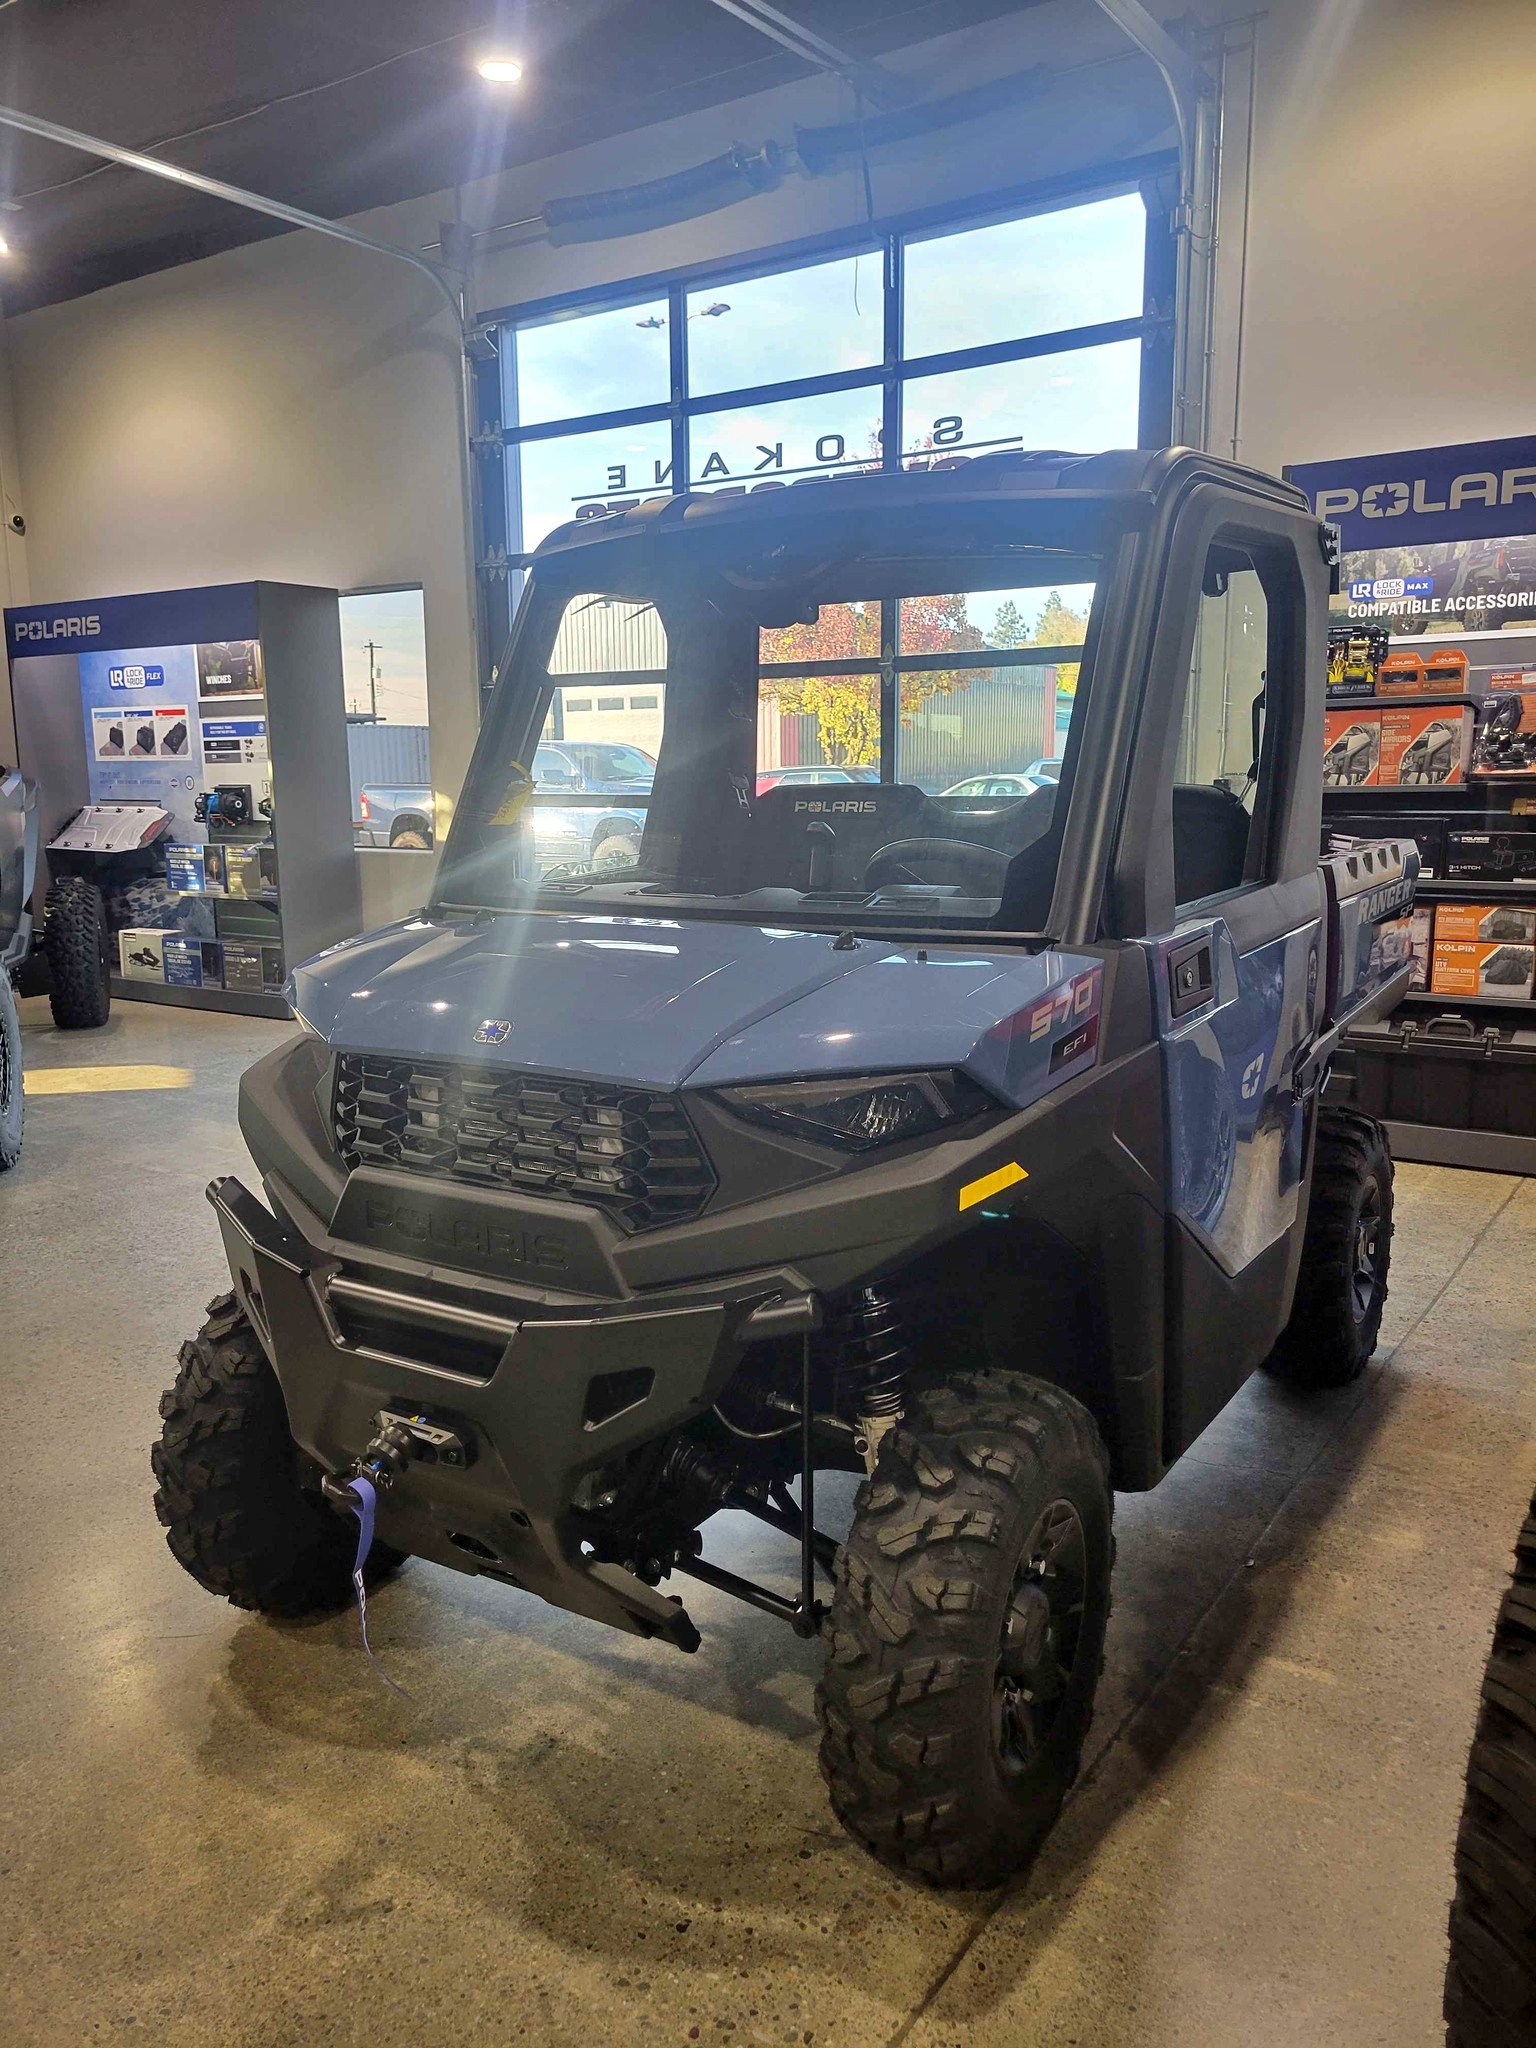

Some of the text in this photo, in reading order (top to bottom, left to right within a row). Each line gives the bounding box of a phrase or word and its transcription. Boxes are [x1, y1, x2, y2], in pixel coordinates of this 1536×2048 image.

[1376, 581, 1402, 589] LOCK
[1406, 582, 1429, 591] MAX
[1348, 591, 1536, 618] COMPATIBLE ACCESSORI
[14, 615, 101, 641] POLARIS
[146, 672, 162, 680] FLEX
[205, 674, 233, 685] WINCHES
[1381, 729, 1395, 737] SIDE
[794, 801, 877, 813] POLARIS
[1358, 878, 1412, 925] RANGER
[1436, 943, 1476, 952] KOLPIN
[1029, 976, 1093, 1043] 570
[1063, 1032, 1087, 1057] EFI
[366, 1200, 570, 1272] POLARIS
